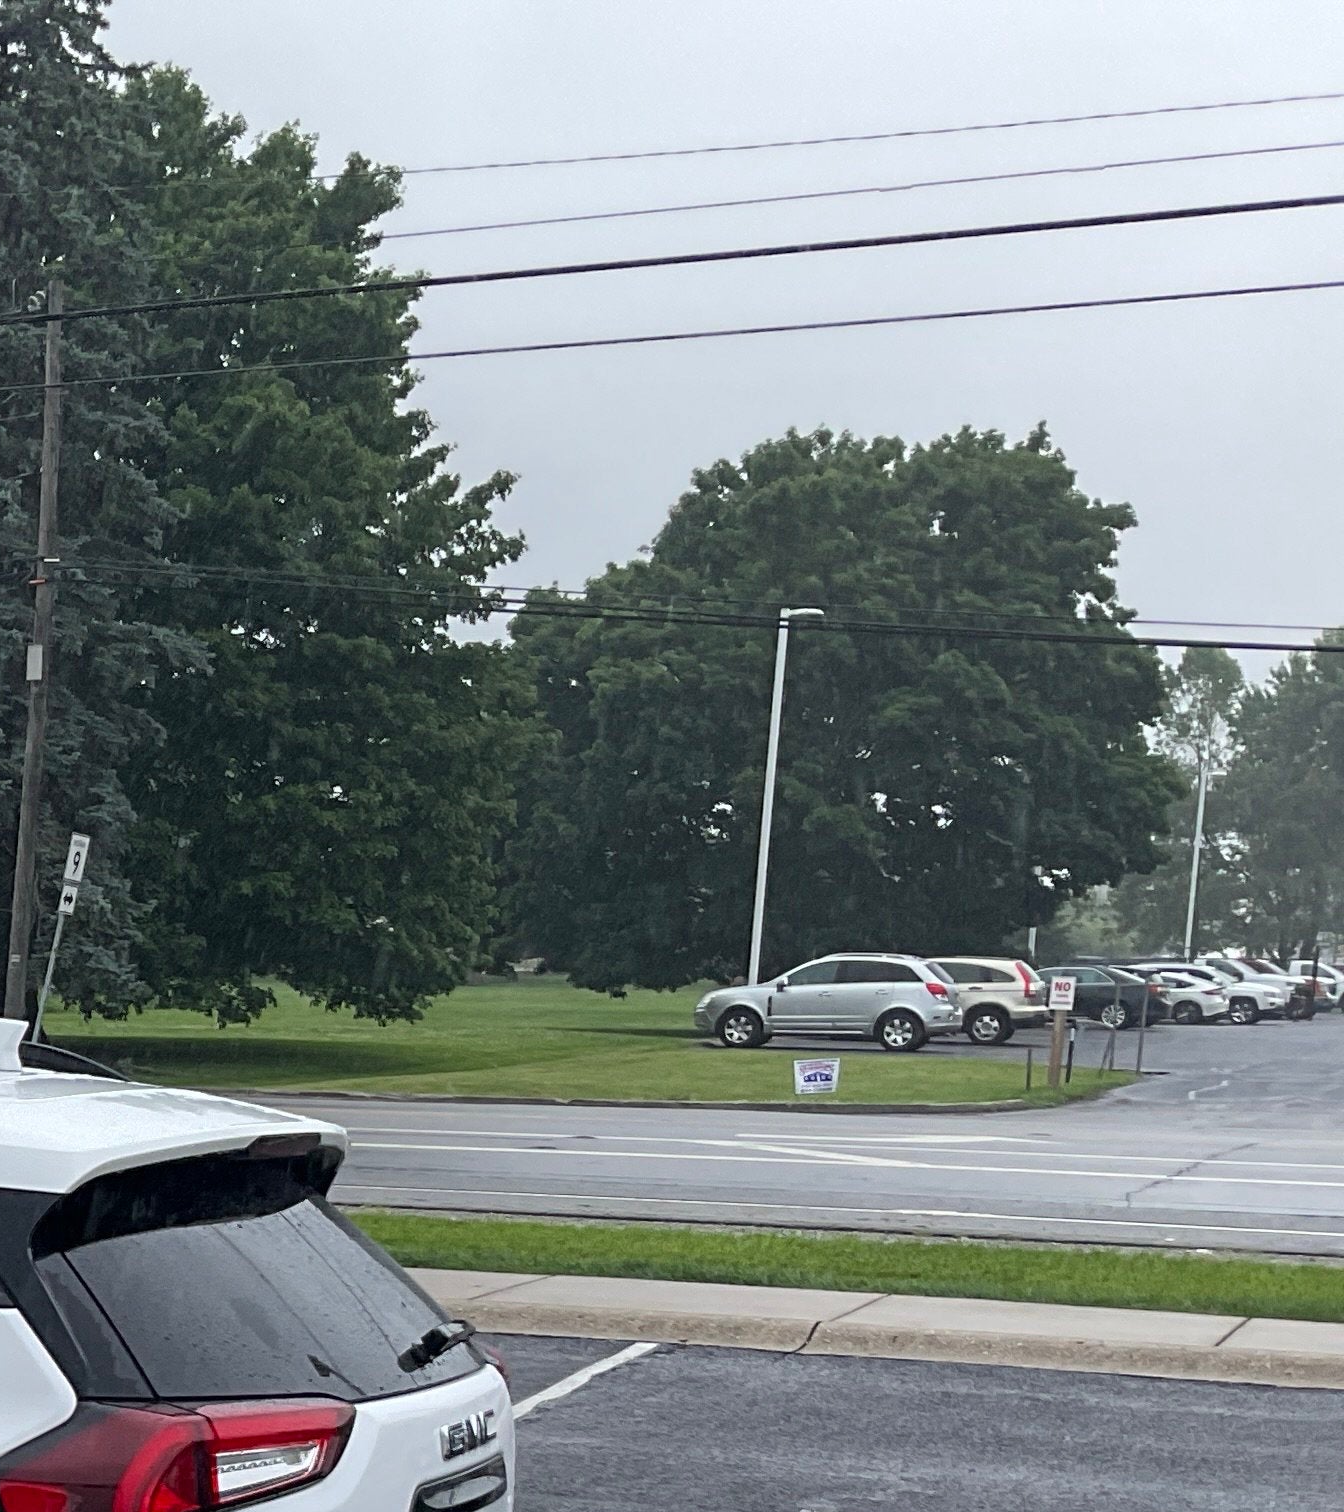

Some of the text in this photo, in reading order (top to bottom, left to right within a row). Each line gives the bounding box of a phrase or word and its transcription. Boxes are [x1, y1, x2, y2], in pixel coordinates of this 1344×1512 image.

[73, 851, 81, 874] 9
[1055, 982, 1071, 991] NO
[441, 1409, 497, 1461] GMC
